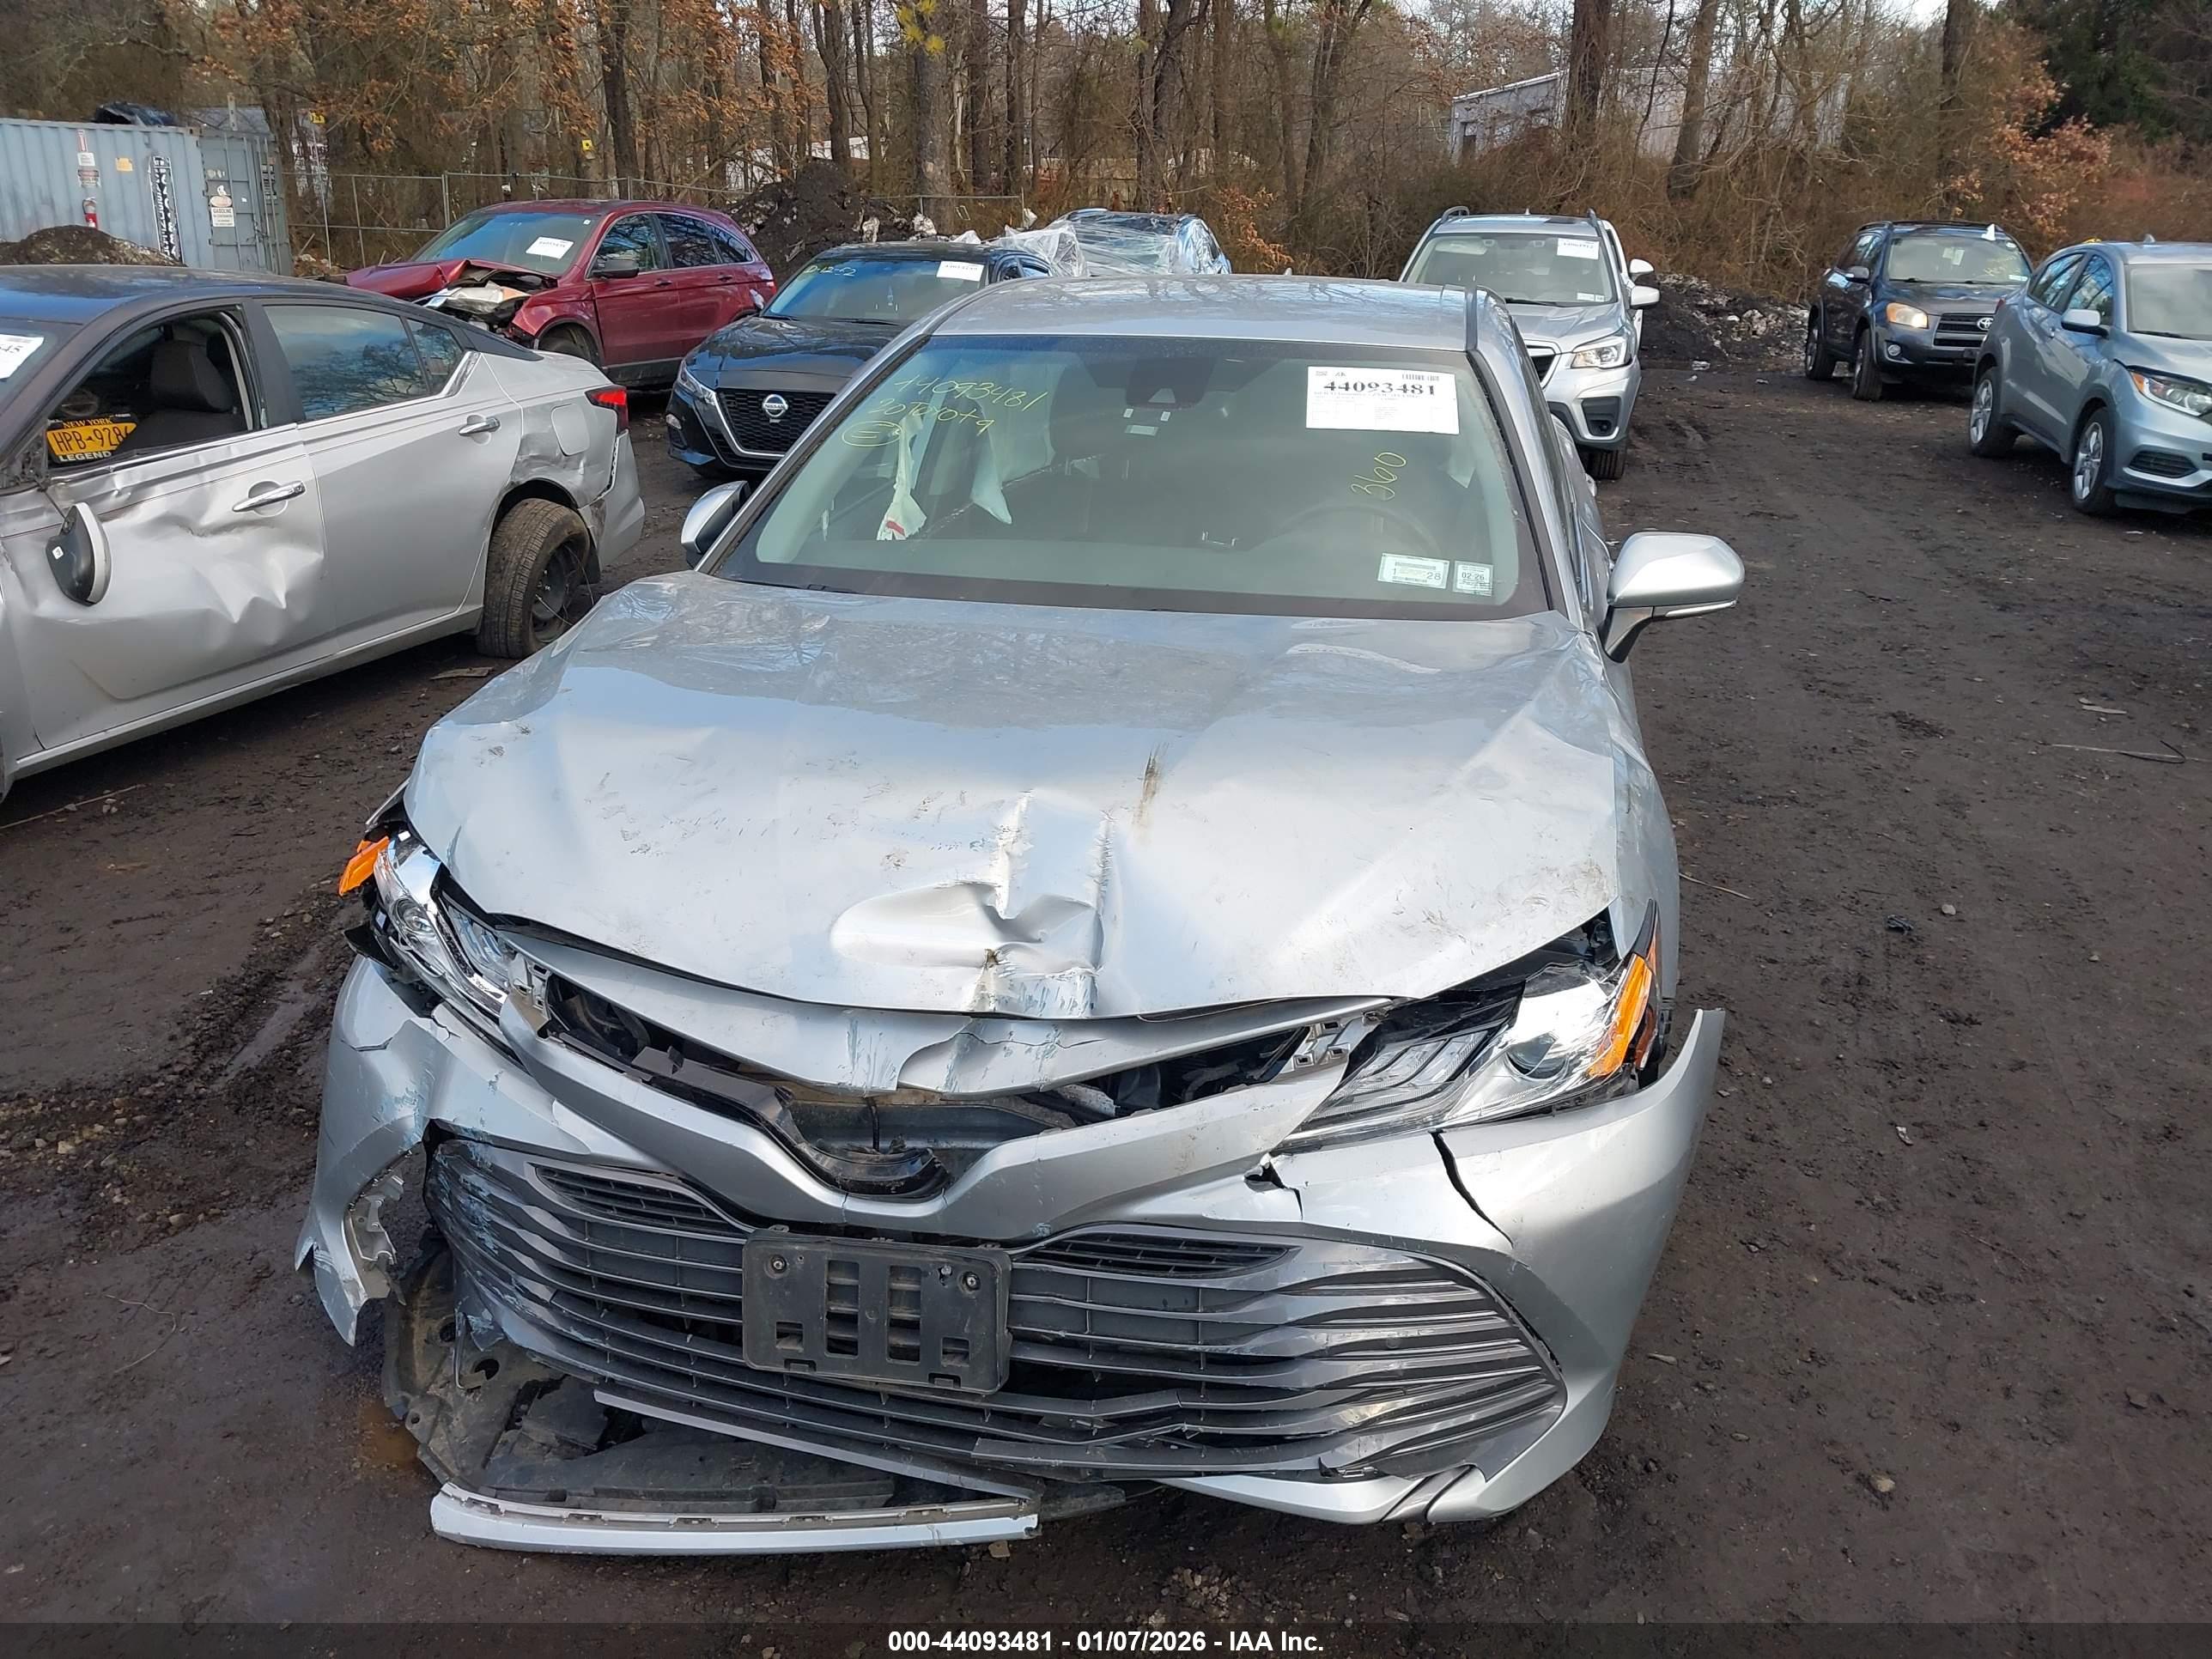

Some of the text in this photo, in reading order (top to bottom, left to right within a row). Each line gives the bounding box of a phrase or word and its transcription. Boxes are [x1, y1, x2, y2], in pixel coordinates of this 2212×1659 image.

[1323, 380, 1435, 396] 44093481
[63, 417, 113, 429] NEW YORK
[58, 451, 112, 462] LEGEND
[1350, 451, 1407, 501] 360
[1425, 571, 1442, 581] 28
